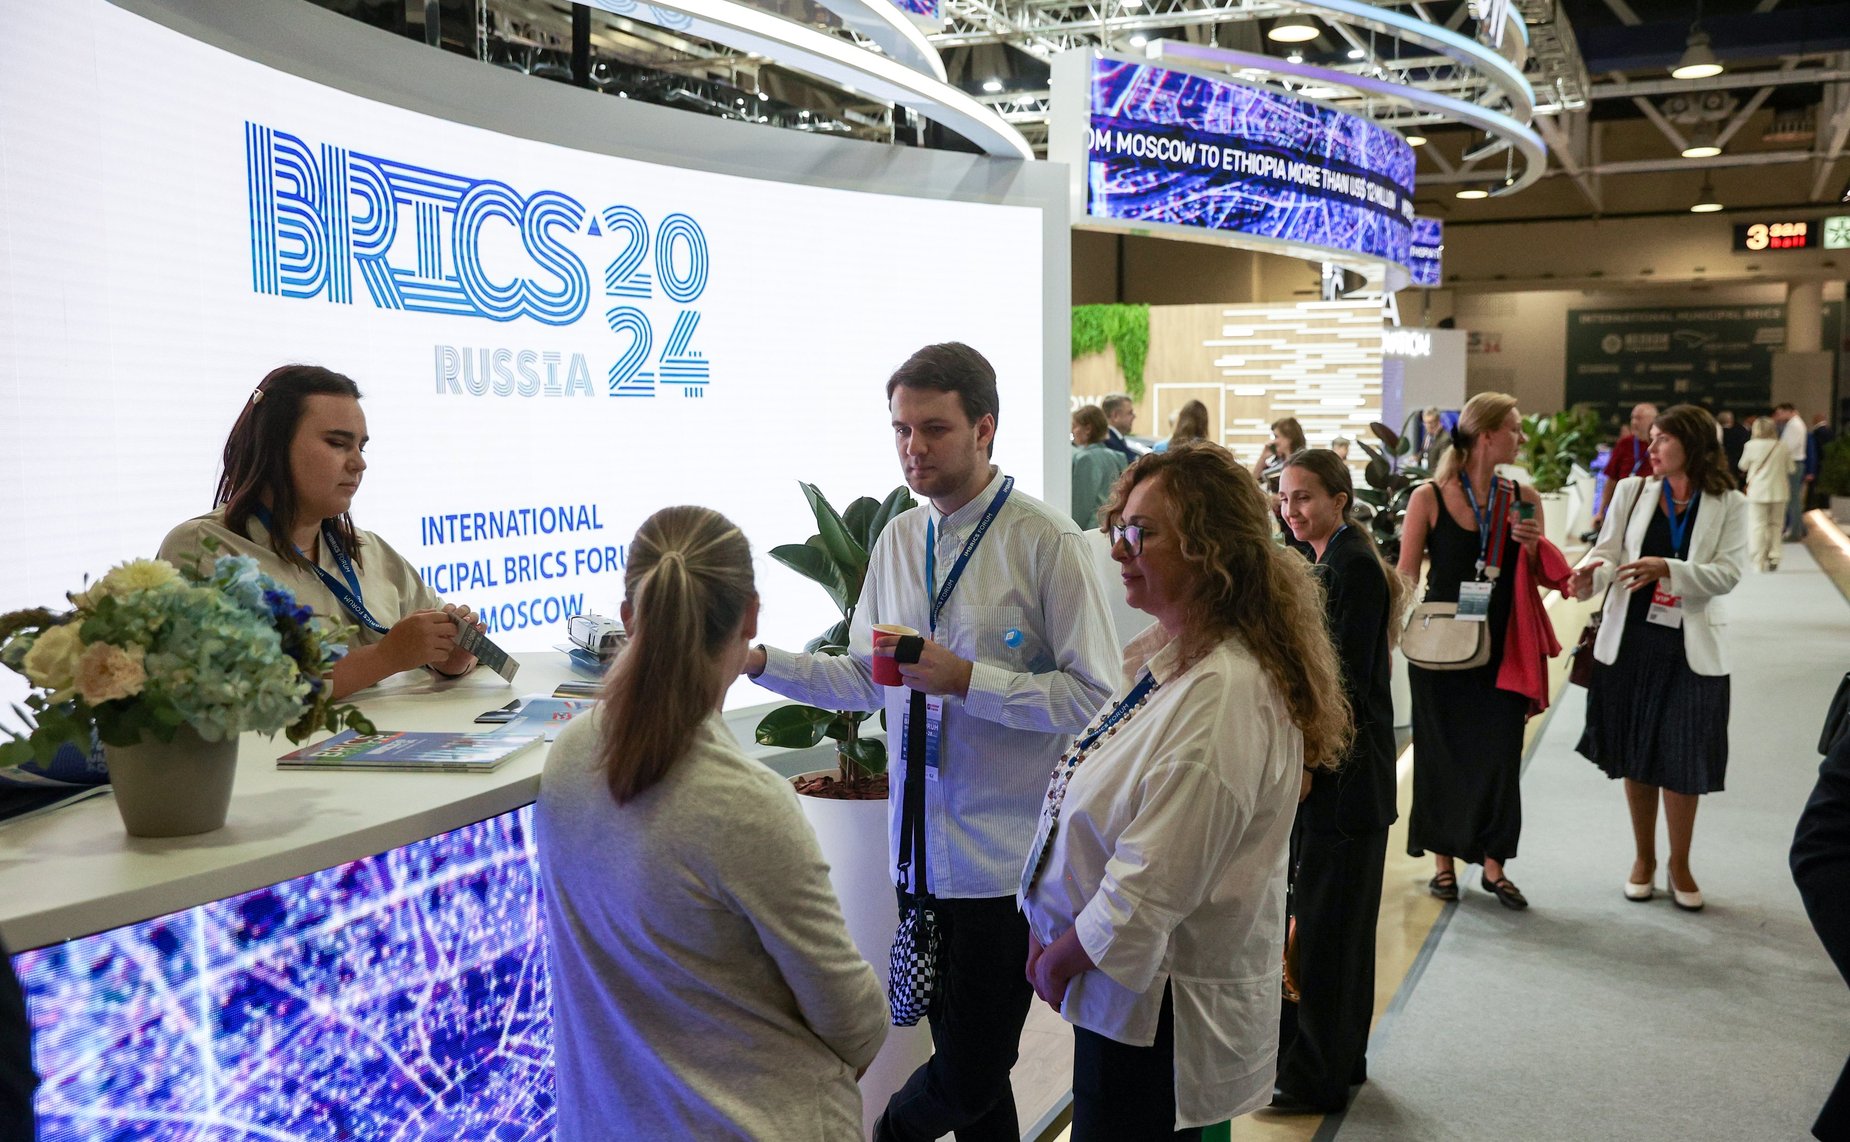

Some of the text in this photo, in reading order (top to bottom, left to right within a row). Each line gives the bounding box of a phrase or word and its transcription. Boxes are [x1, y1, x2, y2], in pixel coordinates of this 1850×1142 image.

[1116, 131, 1197, 165] MOSCOW
[1198, 143, 1220, 169] TO
[1222, 148, 1287, 182] ETHIOPIA
[1288, 160, 1321, 188] MORE
[1321, 168, 1350, 195] THAN
[245, 119, 709, 326] BRICS 20
[1746, 223, 1769, 250] 3
[434, 344, 595, 398] RUSSIA
[606, 305, 710, 398] 24
[421, 504, 604, 546] INTERNATIONAL
[979, 512, 993, 534] FORUM
[421, 545, 627, 594] ICIPAL BRICS FOR
[344, 595, 364, 615] FORUM
[480, 593, 584, 635] MOSCOW
[926, 722, 939, 731] RUM
[1108, 703, 1130, 725] FORUM
